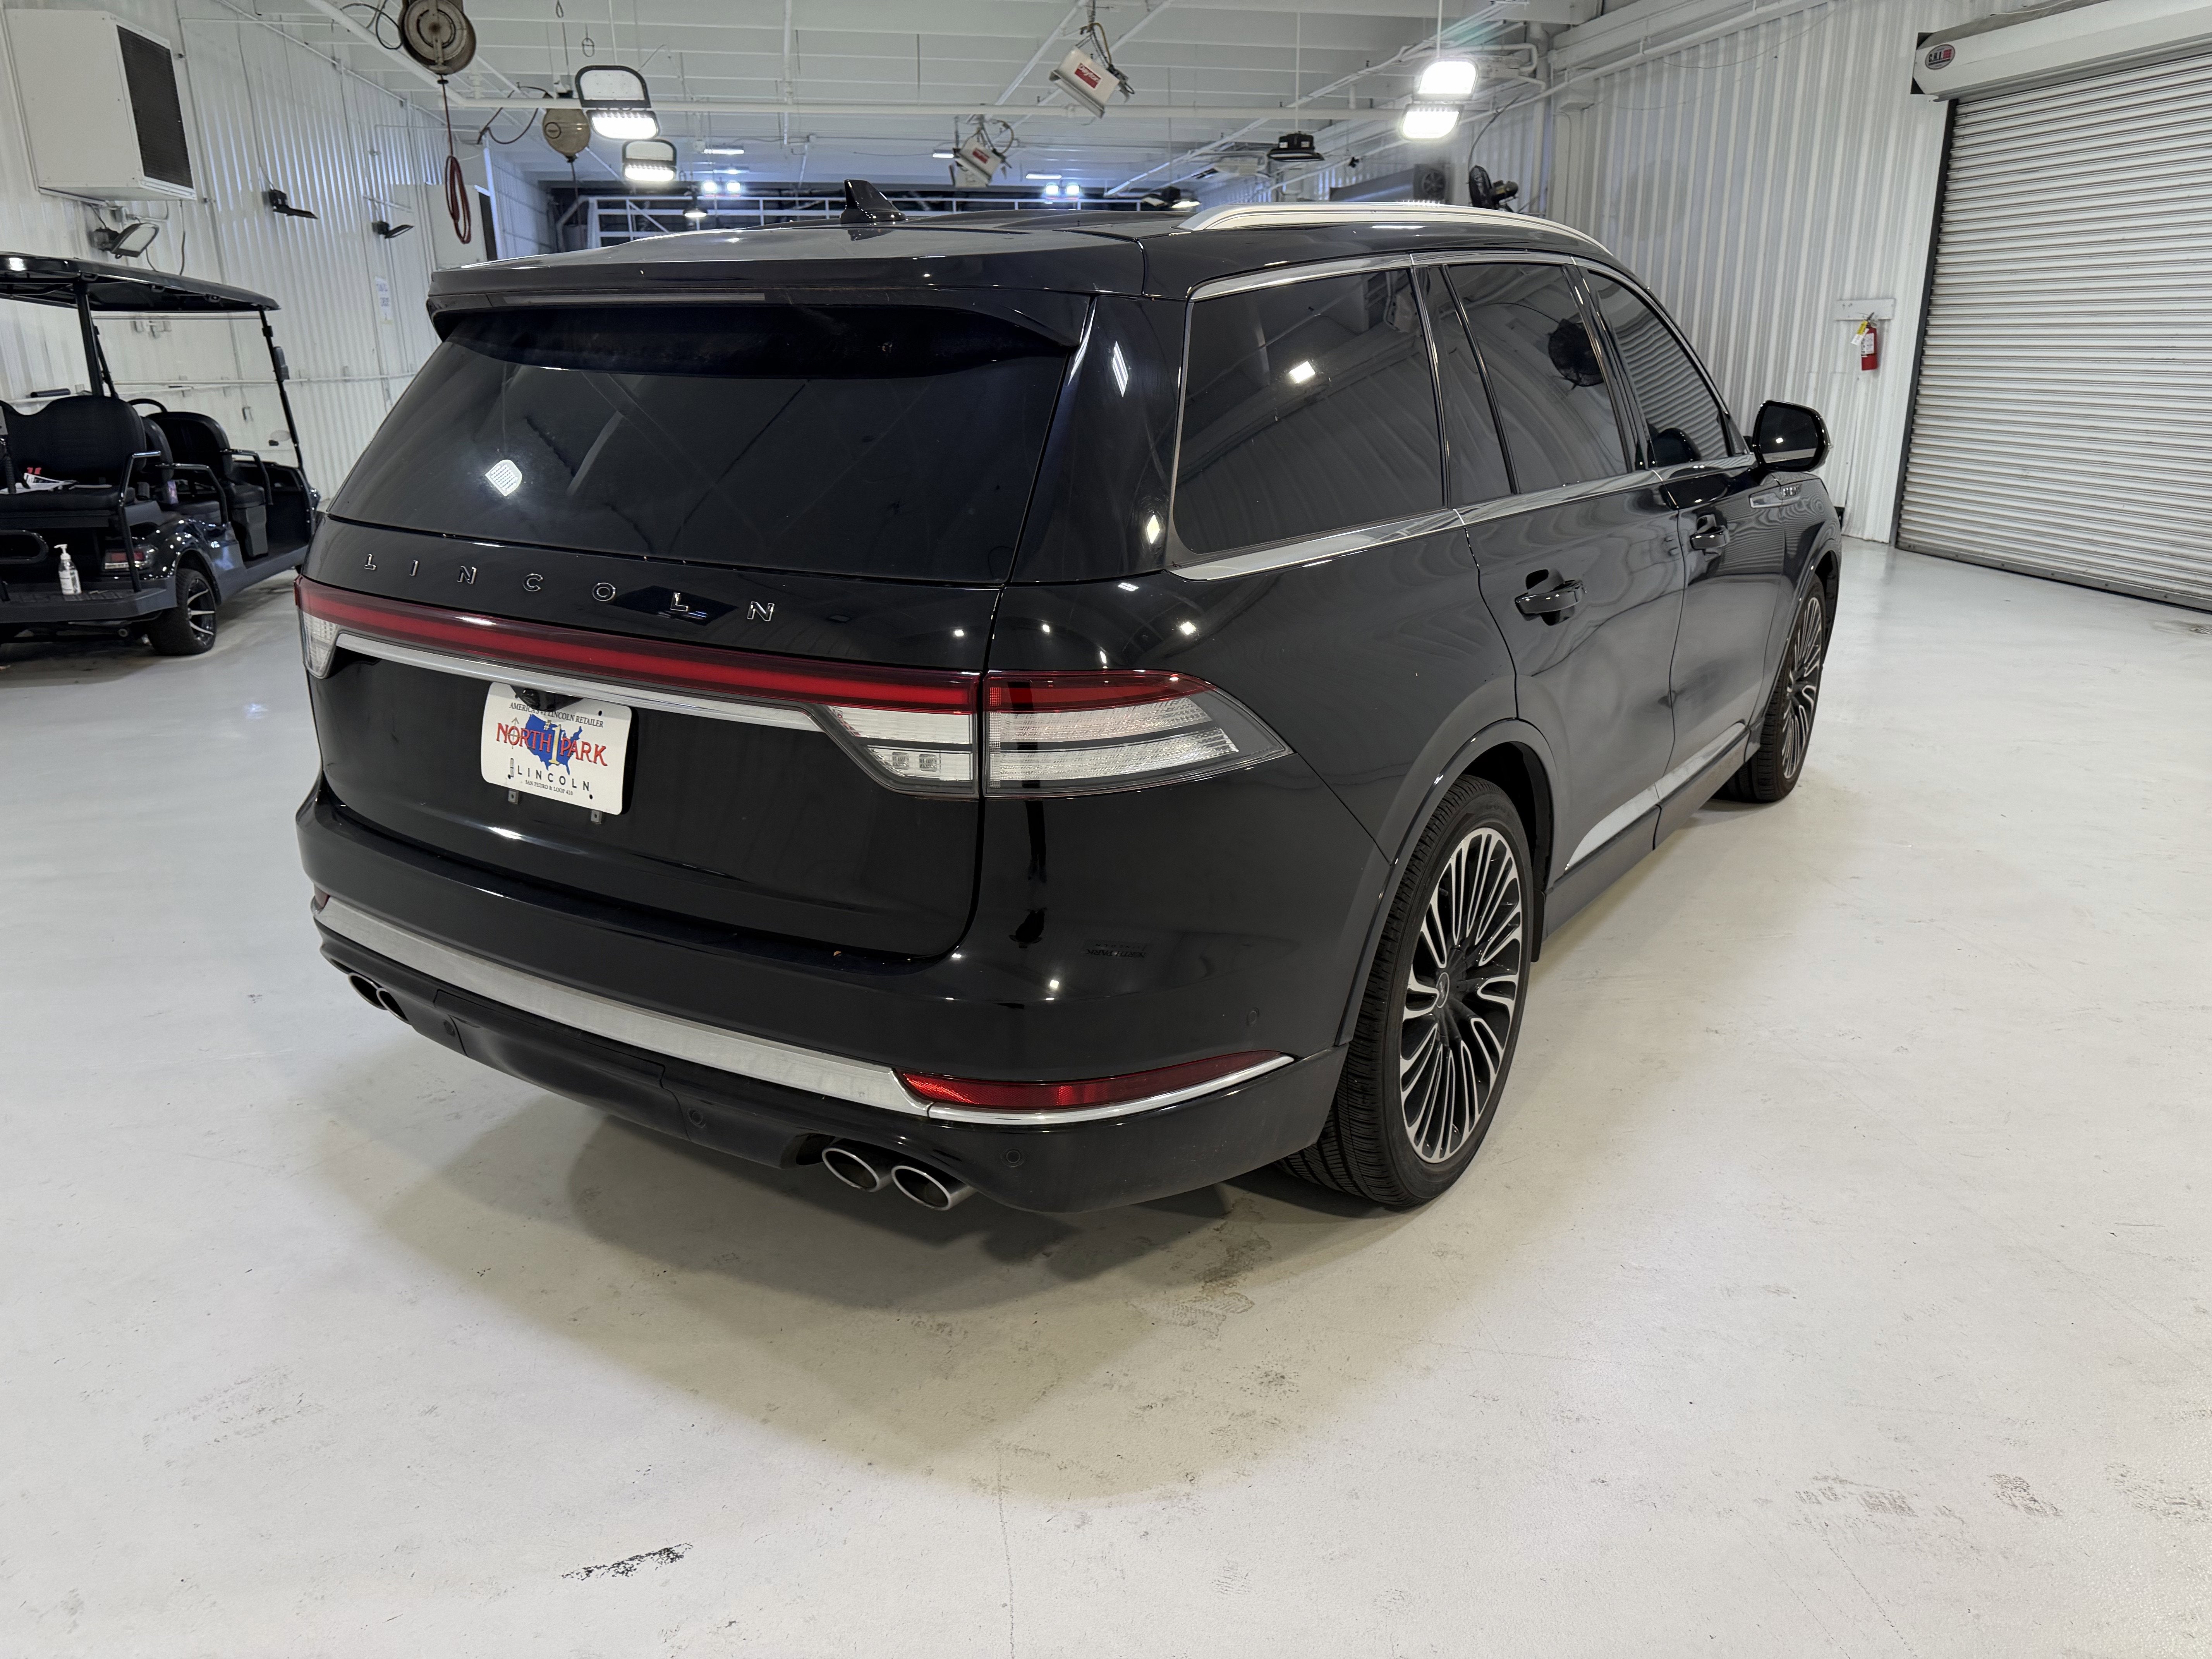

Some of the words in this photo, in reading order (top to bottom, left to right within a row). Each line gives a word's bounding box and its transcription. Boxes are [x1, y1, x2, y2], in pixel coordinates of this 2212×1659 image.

[364, 553, 775, 622] LINCOLN
[509, 702, 539, 714] AMERICA
[548, 710, 575, 721] LINCOLN
[575, 715, 604, 728] RETAILER
[496, 723, 552, 752] NORTH
[560, 737, 608, 766] PARK
[517, 765, 589, 791] LINCOLN
